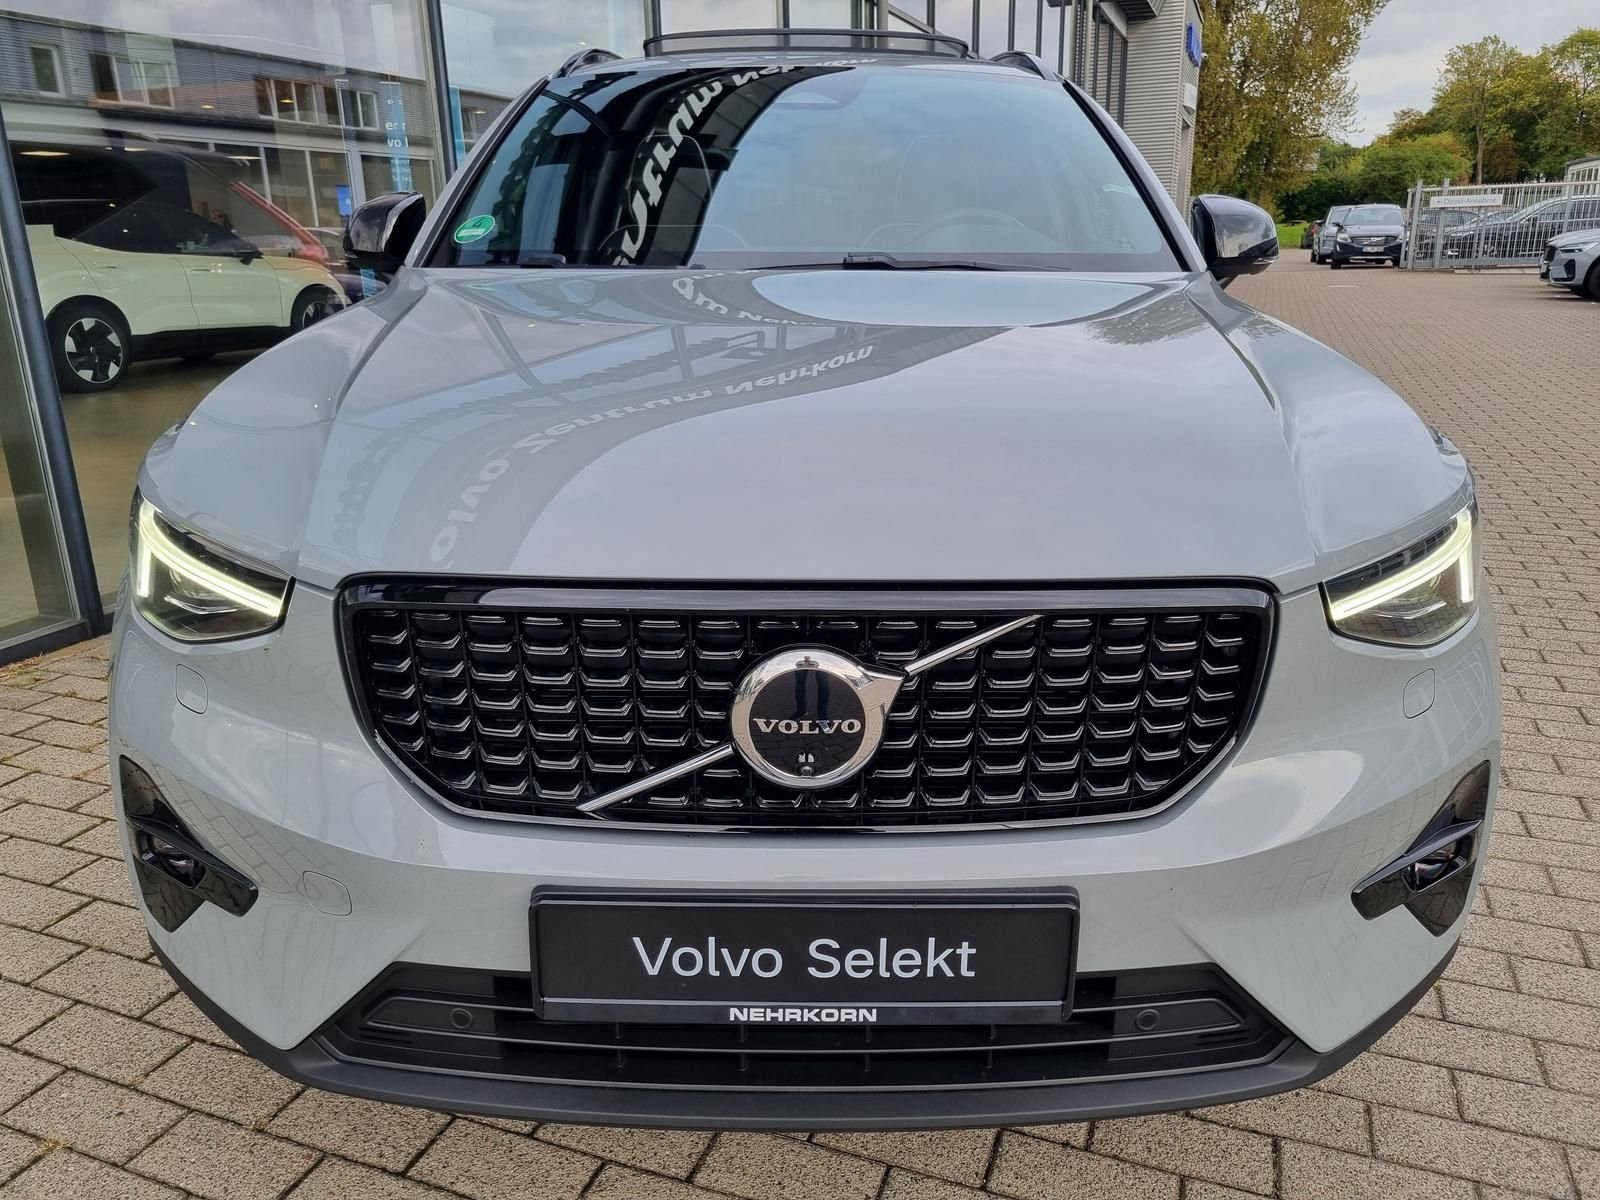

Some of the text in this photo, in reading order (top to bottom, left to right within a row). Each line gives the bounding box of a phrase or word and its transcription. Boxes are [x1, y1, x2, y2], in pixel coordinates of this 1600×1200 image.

[753, 718, 862, 734] VOLVO
[632, 936, 977, 979] Volvo Selekt
[729, 1007, 877, 1023] NEHRKORN
